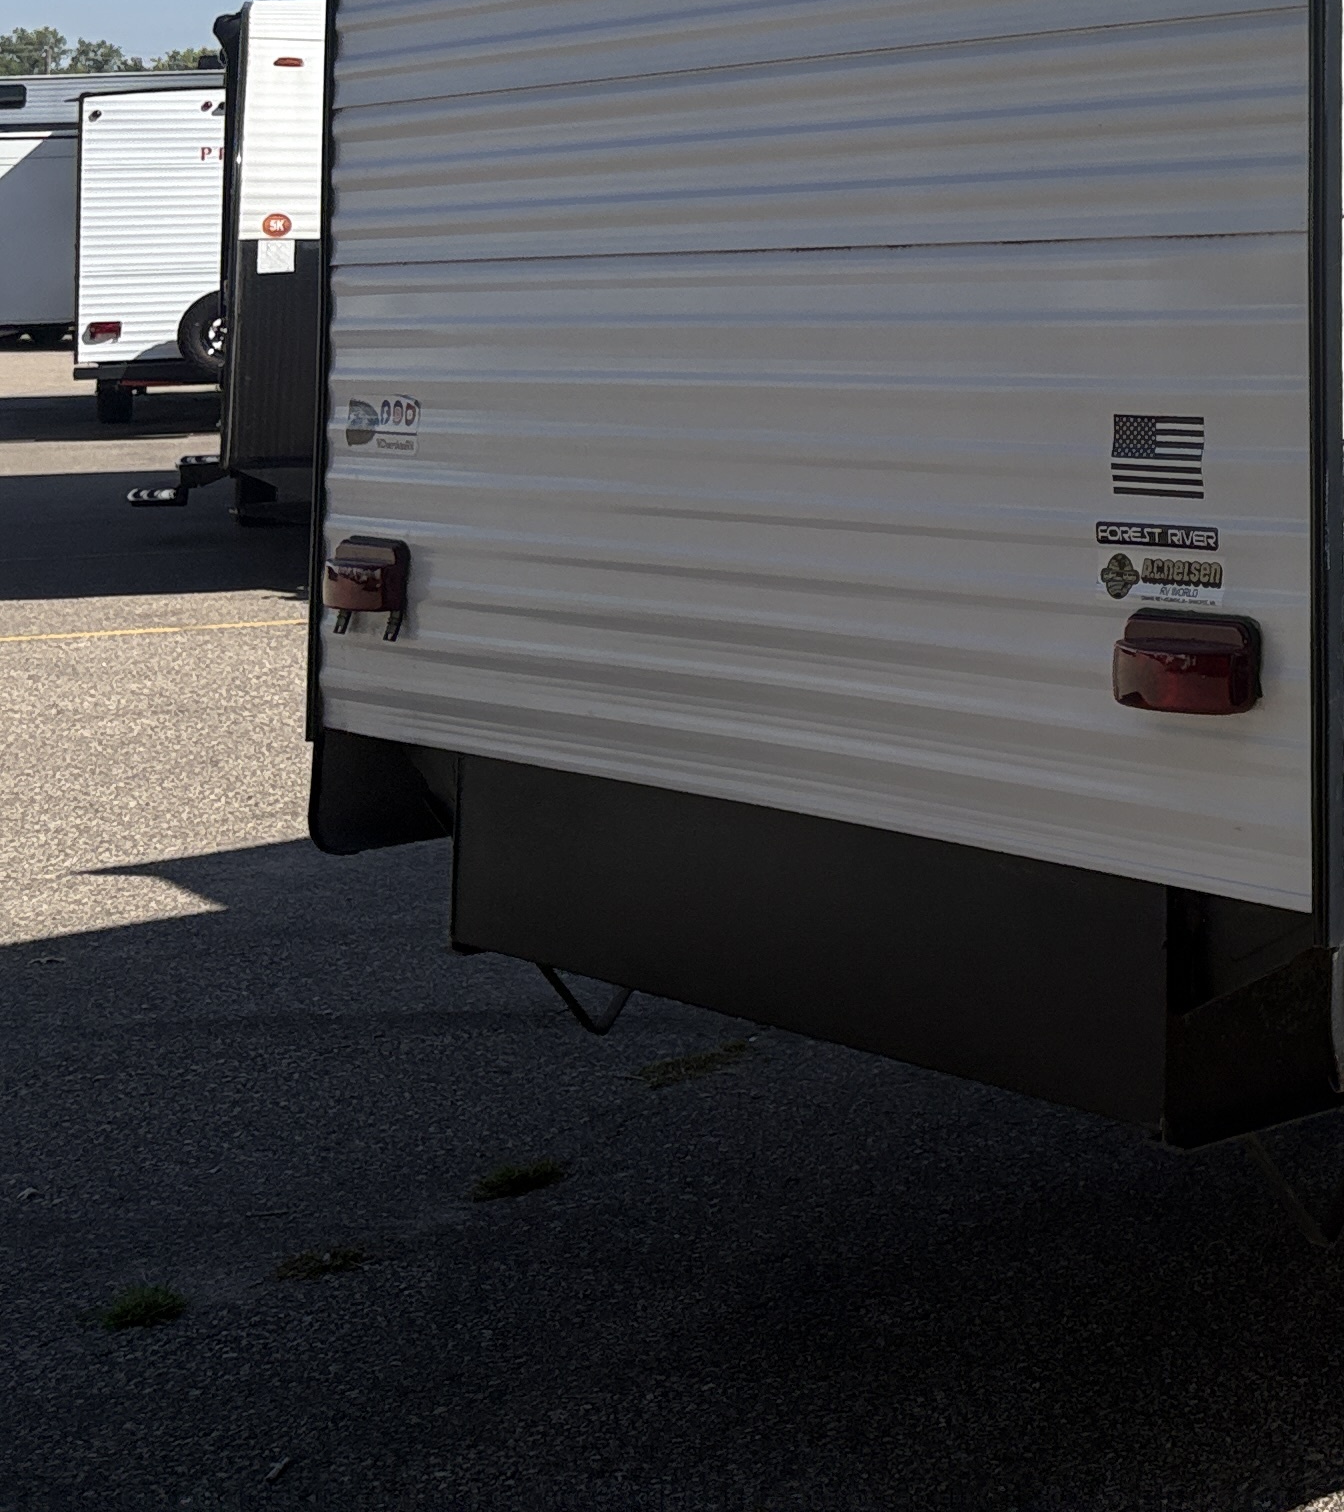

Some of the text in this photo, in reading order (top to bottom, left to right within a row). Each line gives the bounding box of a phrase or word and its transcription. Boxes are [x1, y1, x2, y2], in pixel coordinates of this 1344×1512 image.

[269, 219, 285, 232] 5K
[1098, 526, 1216, 547] FOREST RIVER
